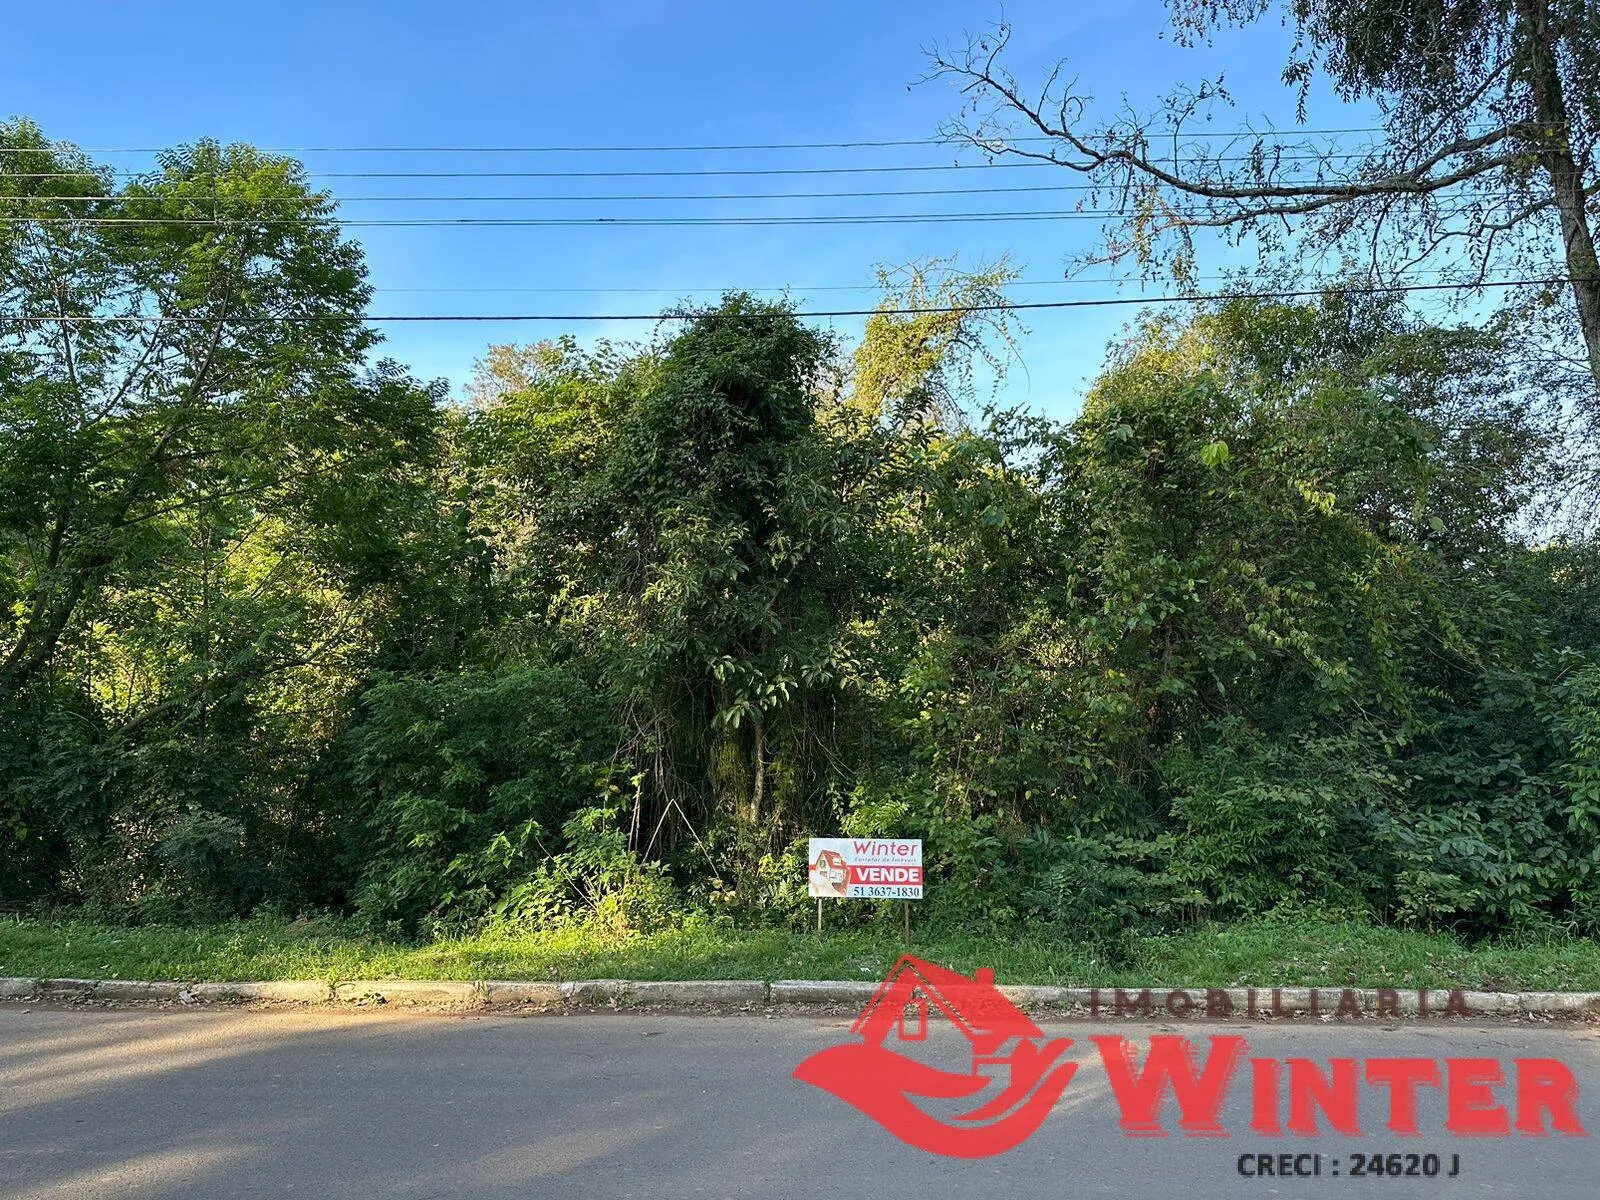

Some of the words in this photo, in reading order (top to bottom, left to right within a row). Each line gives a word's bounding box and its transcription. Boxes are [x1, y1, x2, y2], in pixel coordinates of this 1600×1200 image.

[853, 841, 918, 856] Winter
[856, 867, 920, 883] VENDE
[853, 886, 865, 897] 51
[868, 886, 920, 898] 3637-1830
